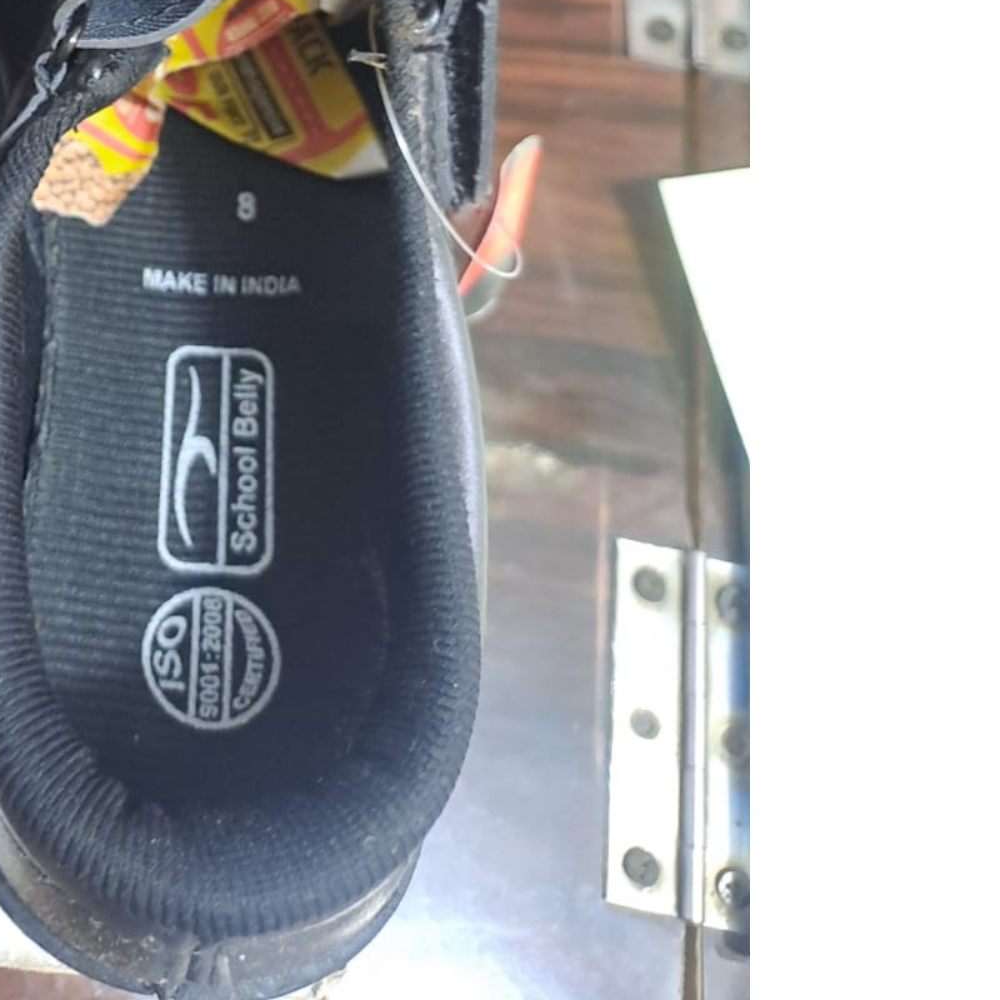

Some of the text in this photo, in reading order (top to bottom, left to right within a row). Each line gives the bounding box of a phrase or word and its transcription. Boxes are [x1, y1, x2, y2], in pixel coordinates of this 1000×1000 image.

[236, 191, 256, 222] 8
[142, 267, 301, 296] MAKE IN INDIA
[230, 368, 264, 554] School Belly
[153, 615, 187, 691] ISO
